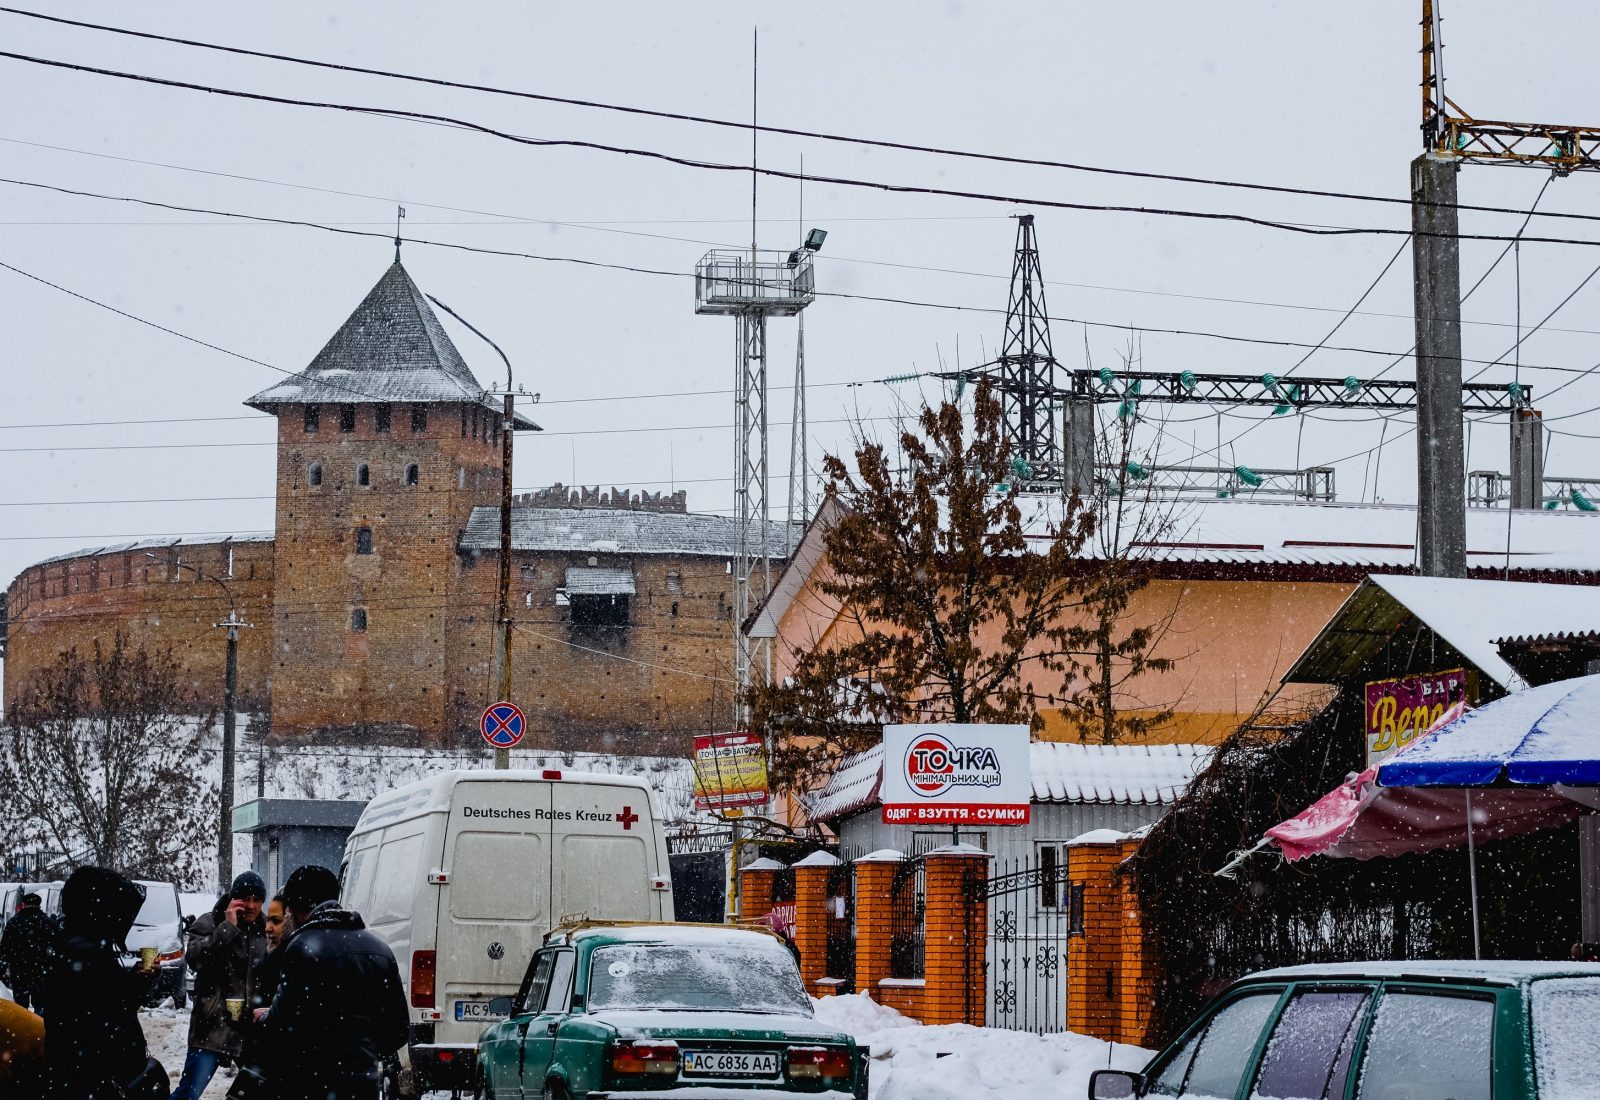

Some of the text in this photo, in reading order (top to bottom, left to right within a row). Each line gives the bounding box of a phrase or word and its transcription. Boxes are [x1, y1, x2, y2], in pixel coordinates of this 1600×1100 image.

[1422, 679, 1458, 696] БАР
[914, 750, 997, 771] ТОЧКА
[913, 773, 999, 786] МІНІМАЛЬНИХ ЦІН
[463, 806, 612, 822] Deutsches Rotes Kreuz
[886, 808, 1025, 820] ОДЯГ ВЗУТТЯ СУМКИ
[694, 1055, 714, 1070] AC
[718, 1055, 749, 1071] 6836
[752, 1056, 772, 1071] AA
